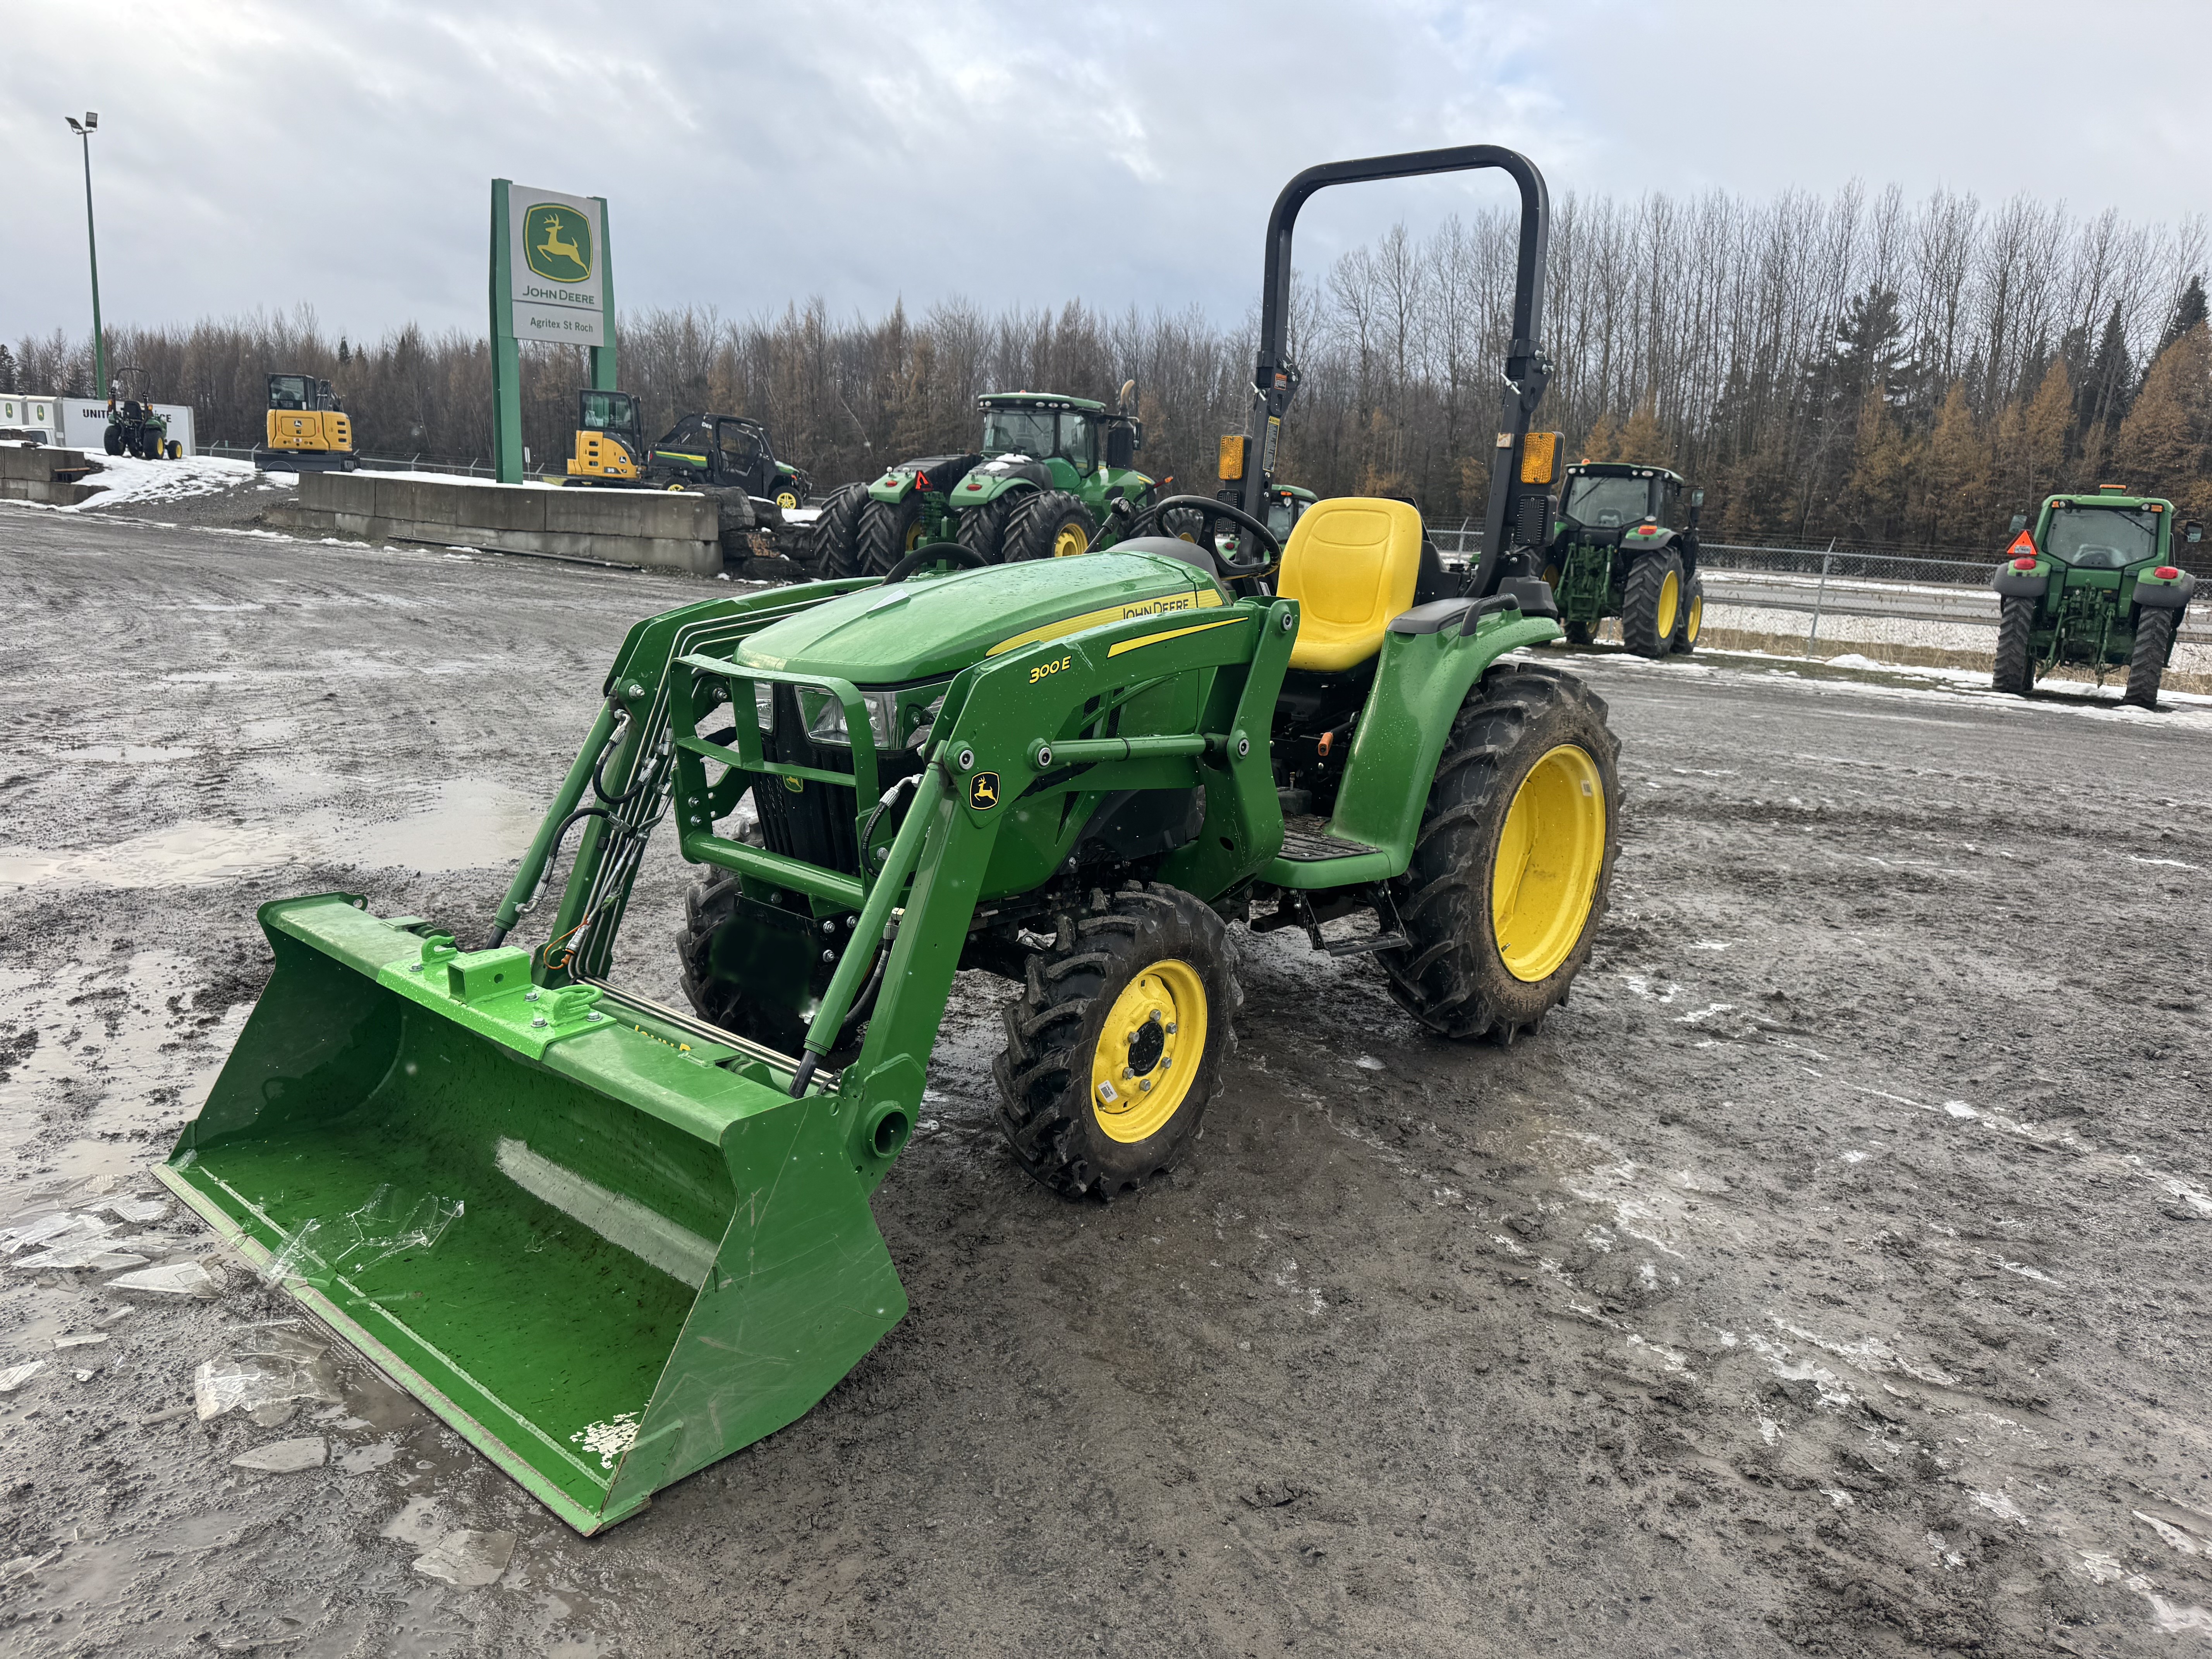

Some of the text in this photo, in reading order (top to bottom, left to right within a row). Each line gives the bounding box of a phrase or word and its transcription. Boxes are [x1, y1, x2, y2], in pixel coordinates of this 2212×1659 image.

[522, 285, 594, 304] JOHN DEERE
[531, 317, 593, 333] Agritex St Roch
[82, 409, 109, 419] UNIT
[1154, 599, 1189, 614] DEERE
